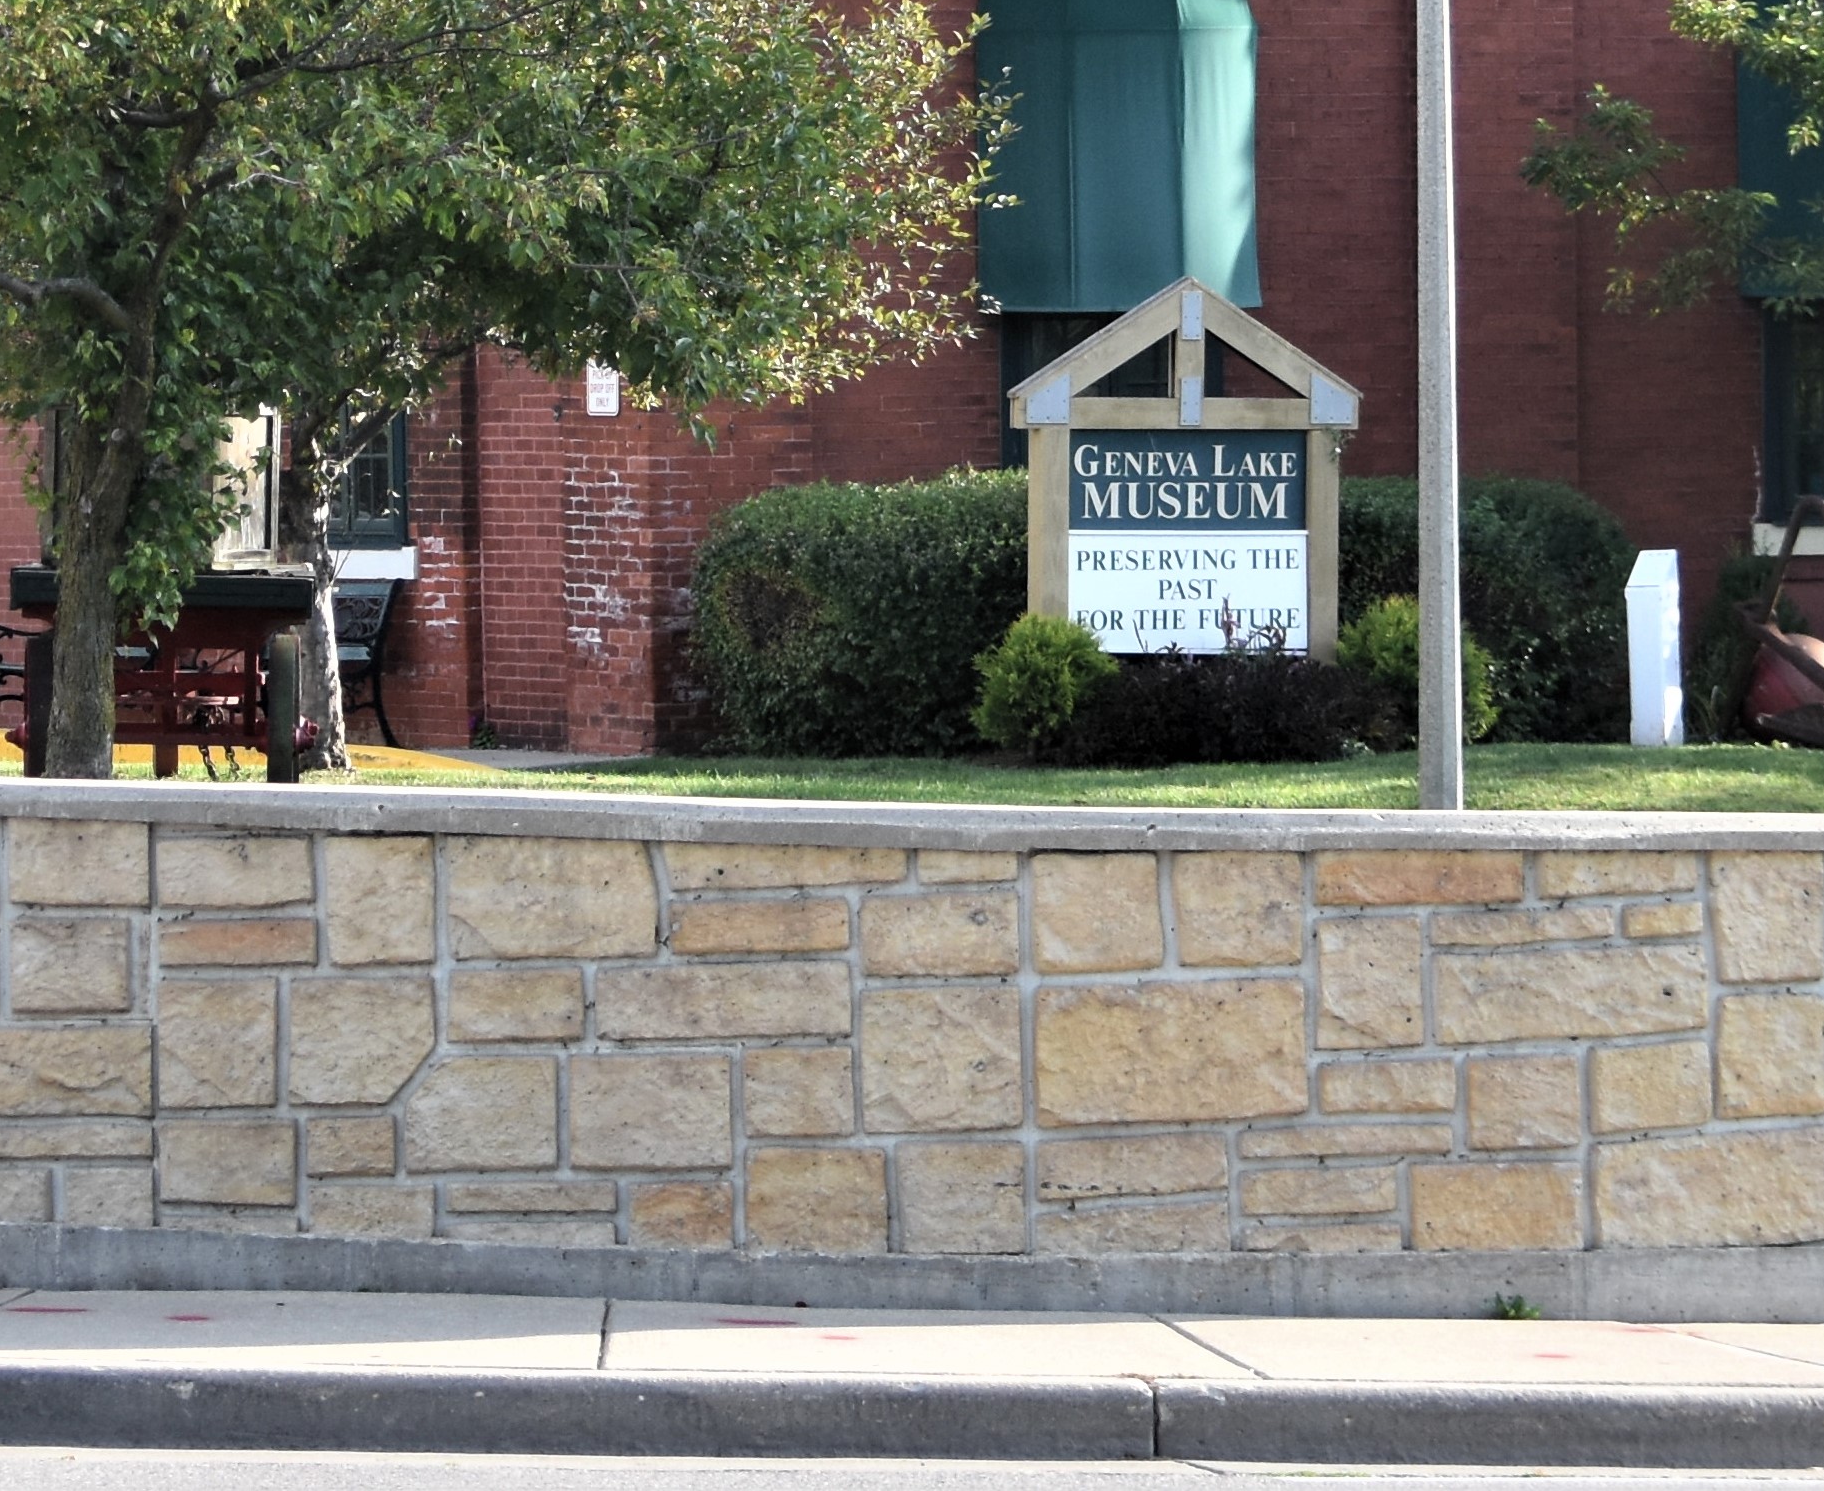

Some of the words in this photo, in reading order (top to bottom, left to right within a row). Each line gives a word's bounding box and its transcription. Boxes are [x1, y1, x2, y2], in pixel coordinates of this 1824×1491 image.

[590, 383, 604, 394] DROP
[605, 383, 615, 394] OFF
[595, 397, 609, 407] ONLY
[1074, 444, 1199, 477] GENEVA
[1211, 444, 1297, 477] LAKE
[1081, 481, 1289, 519] MUSEUM
[1076, 548, 1237, 571] PRESERVING
[1248, 548, 1299, 570] THE
[1158, 579, 1218, 600] PAST
[1076, 609, 1124, 631] FOR
[1133, 609, 1186, 630] THE
[1199, 607, 1300, 630] FUTURE
